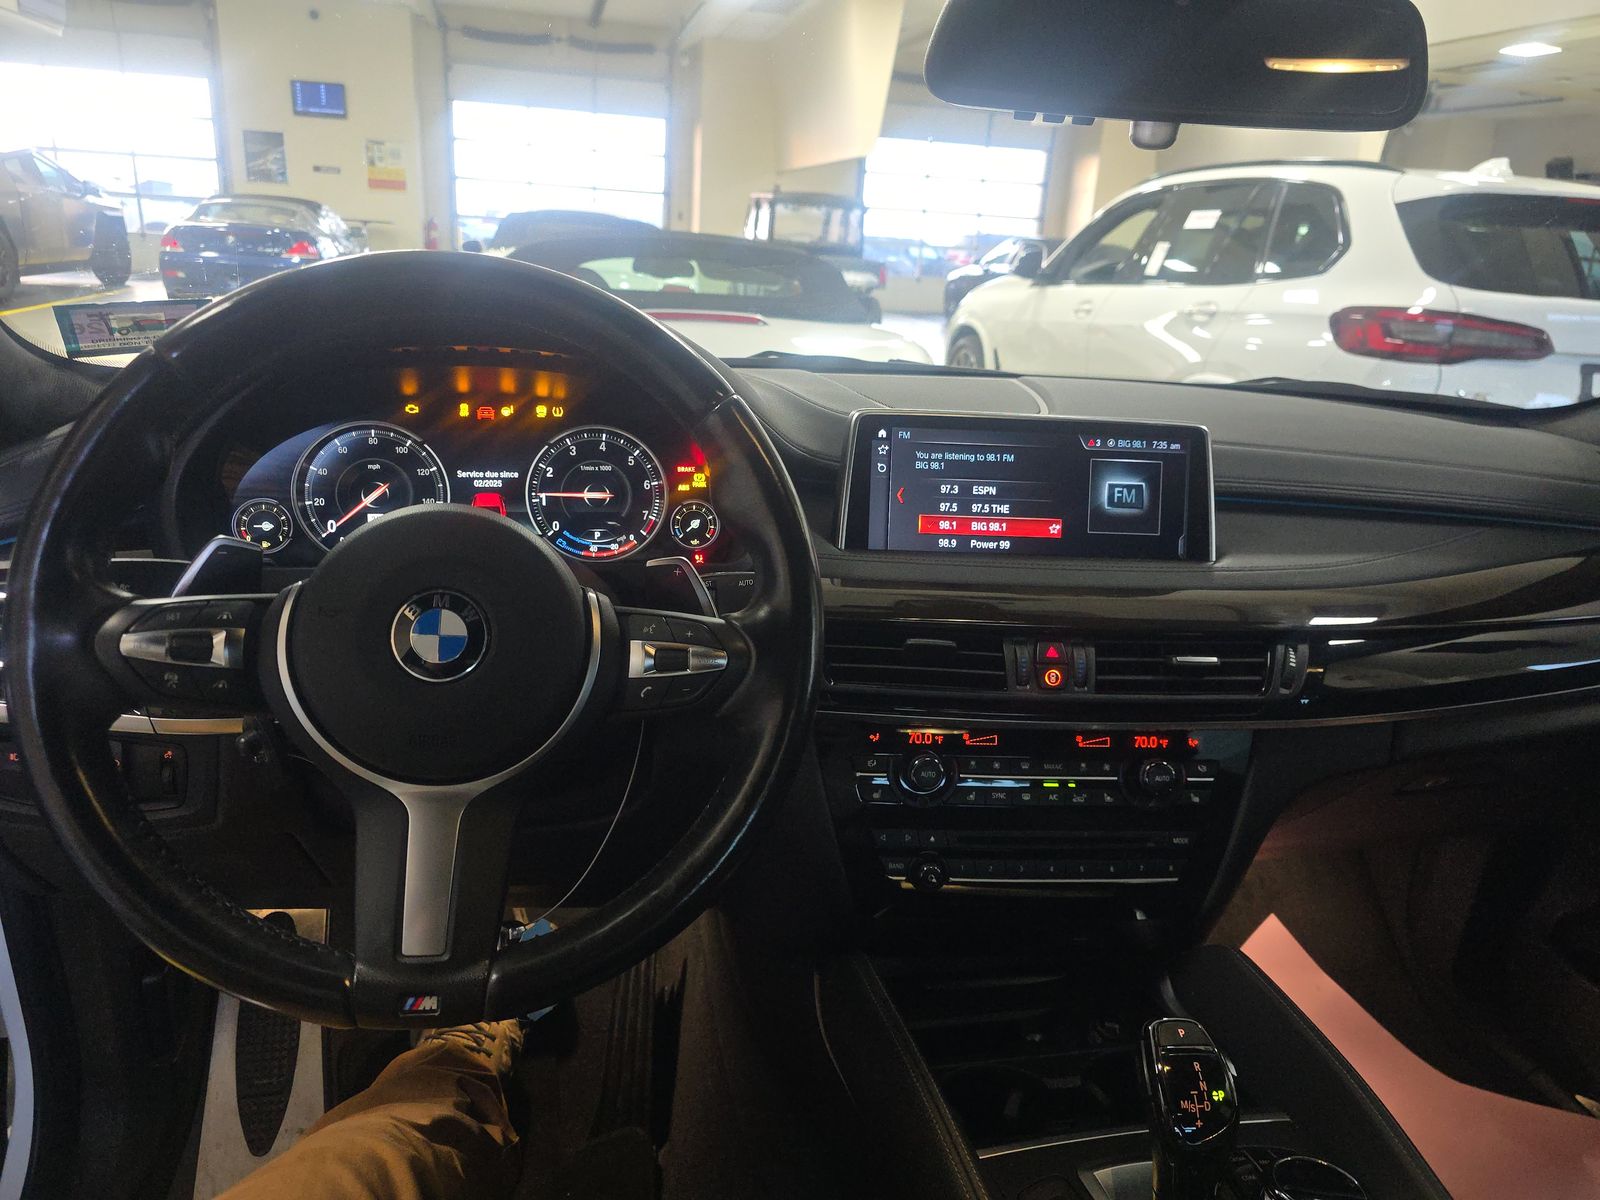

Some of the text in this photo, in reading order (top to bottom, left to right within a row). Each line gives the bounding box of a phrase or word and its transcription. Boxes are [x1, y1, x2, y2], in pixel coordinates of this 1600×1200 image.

[368, 437, 378, 445] 80
[1132, 440, 1146, 448] 98.1
[1152, 441, 1167, 449] 7:35
[338, 446, 348, 454] 60
[395, 446, 408, 454] 100
[569, 446, 576, 456] 3
[599, 442, 606, 452] 4
[628, 456, 634, 466] 5
[916, 451, 929, 460] You
[944, 452, 974, 462] listening
[977, 453, 984, 461] to
[986, 454, 1001, 462] 98.1
[930, 462, 944, 470] 98.1
[317, 468, 328, 476] 40
[417, 468, 430, 476] 120
[457, 470, 519, 478] Service due since
[546, 467, 554, 477] 2
[474, 480, 502, 488] 02/2025
[643, 480, 650, 489] 6
[940, 485, 996, 496] 97.3 ESPN
[1114, 487, 1135, 503] FM
[314, 498, 325, 506] 20
[540, 493, 547, 506] 1
[939, 503, 1010, 514] 97.5 97.5 THE
[642, 511, 649, 520] 7
[327, 520, 337, 533] 0
[552, 521, 560, 531] 0
[938, 521, 1006, 532] 98.1 BIG 98.1
[594, 531, 600, 540] P
[938, 539, 1010, 550] 98.9 Power 99
[738, 579, 754, 587] AUTO
[403, 594, 480, 622] BMW
[908, 732, 932, 744] 70.0
[1134, 736, 1158, 748] 70.0
[1178, 1028, 1185, 1038] P
[1193, 1061, 1201, 1072] R
[1200, 1081, 1208, 1091] N
[1204, 1101, 1211, 1111] D
